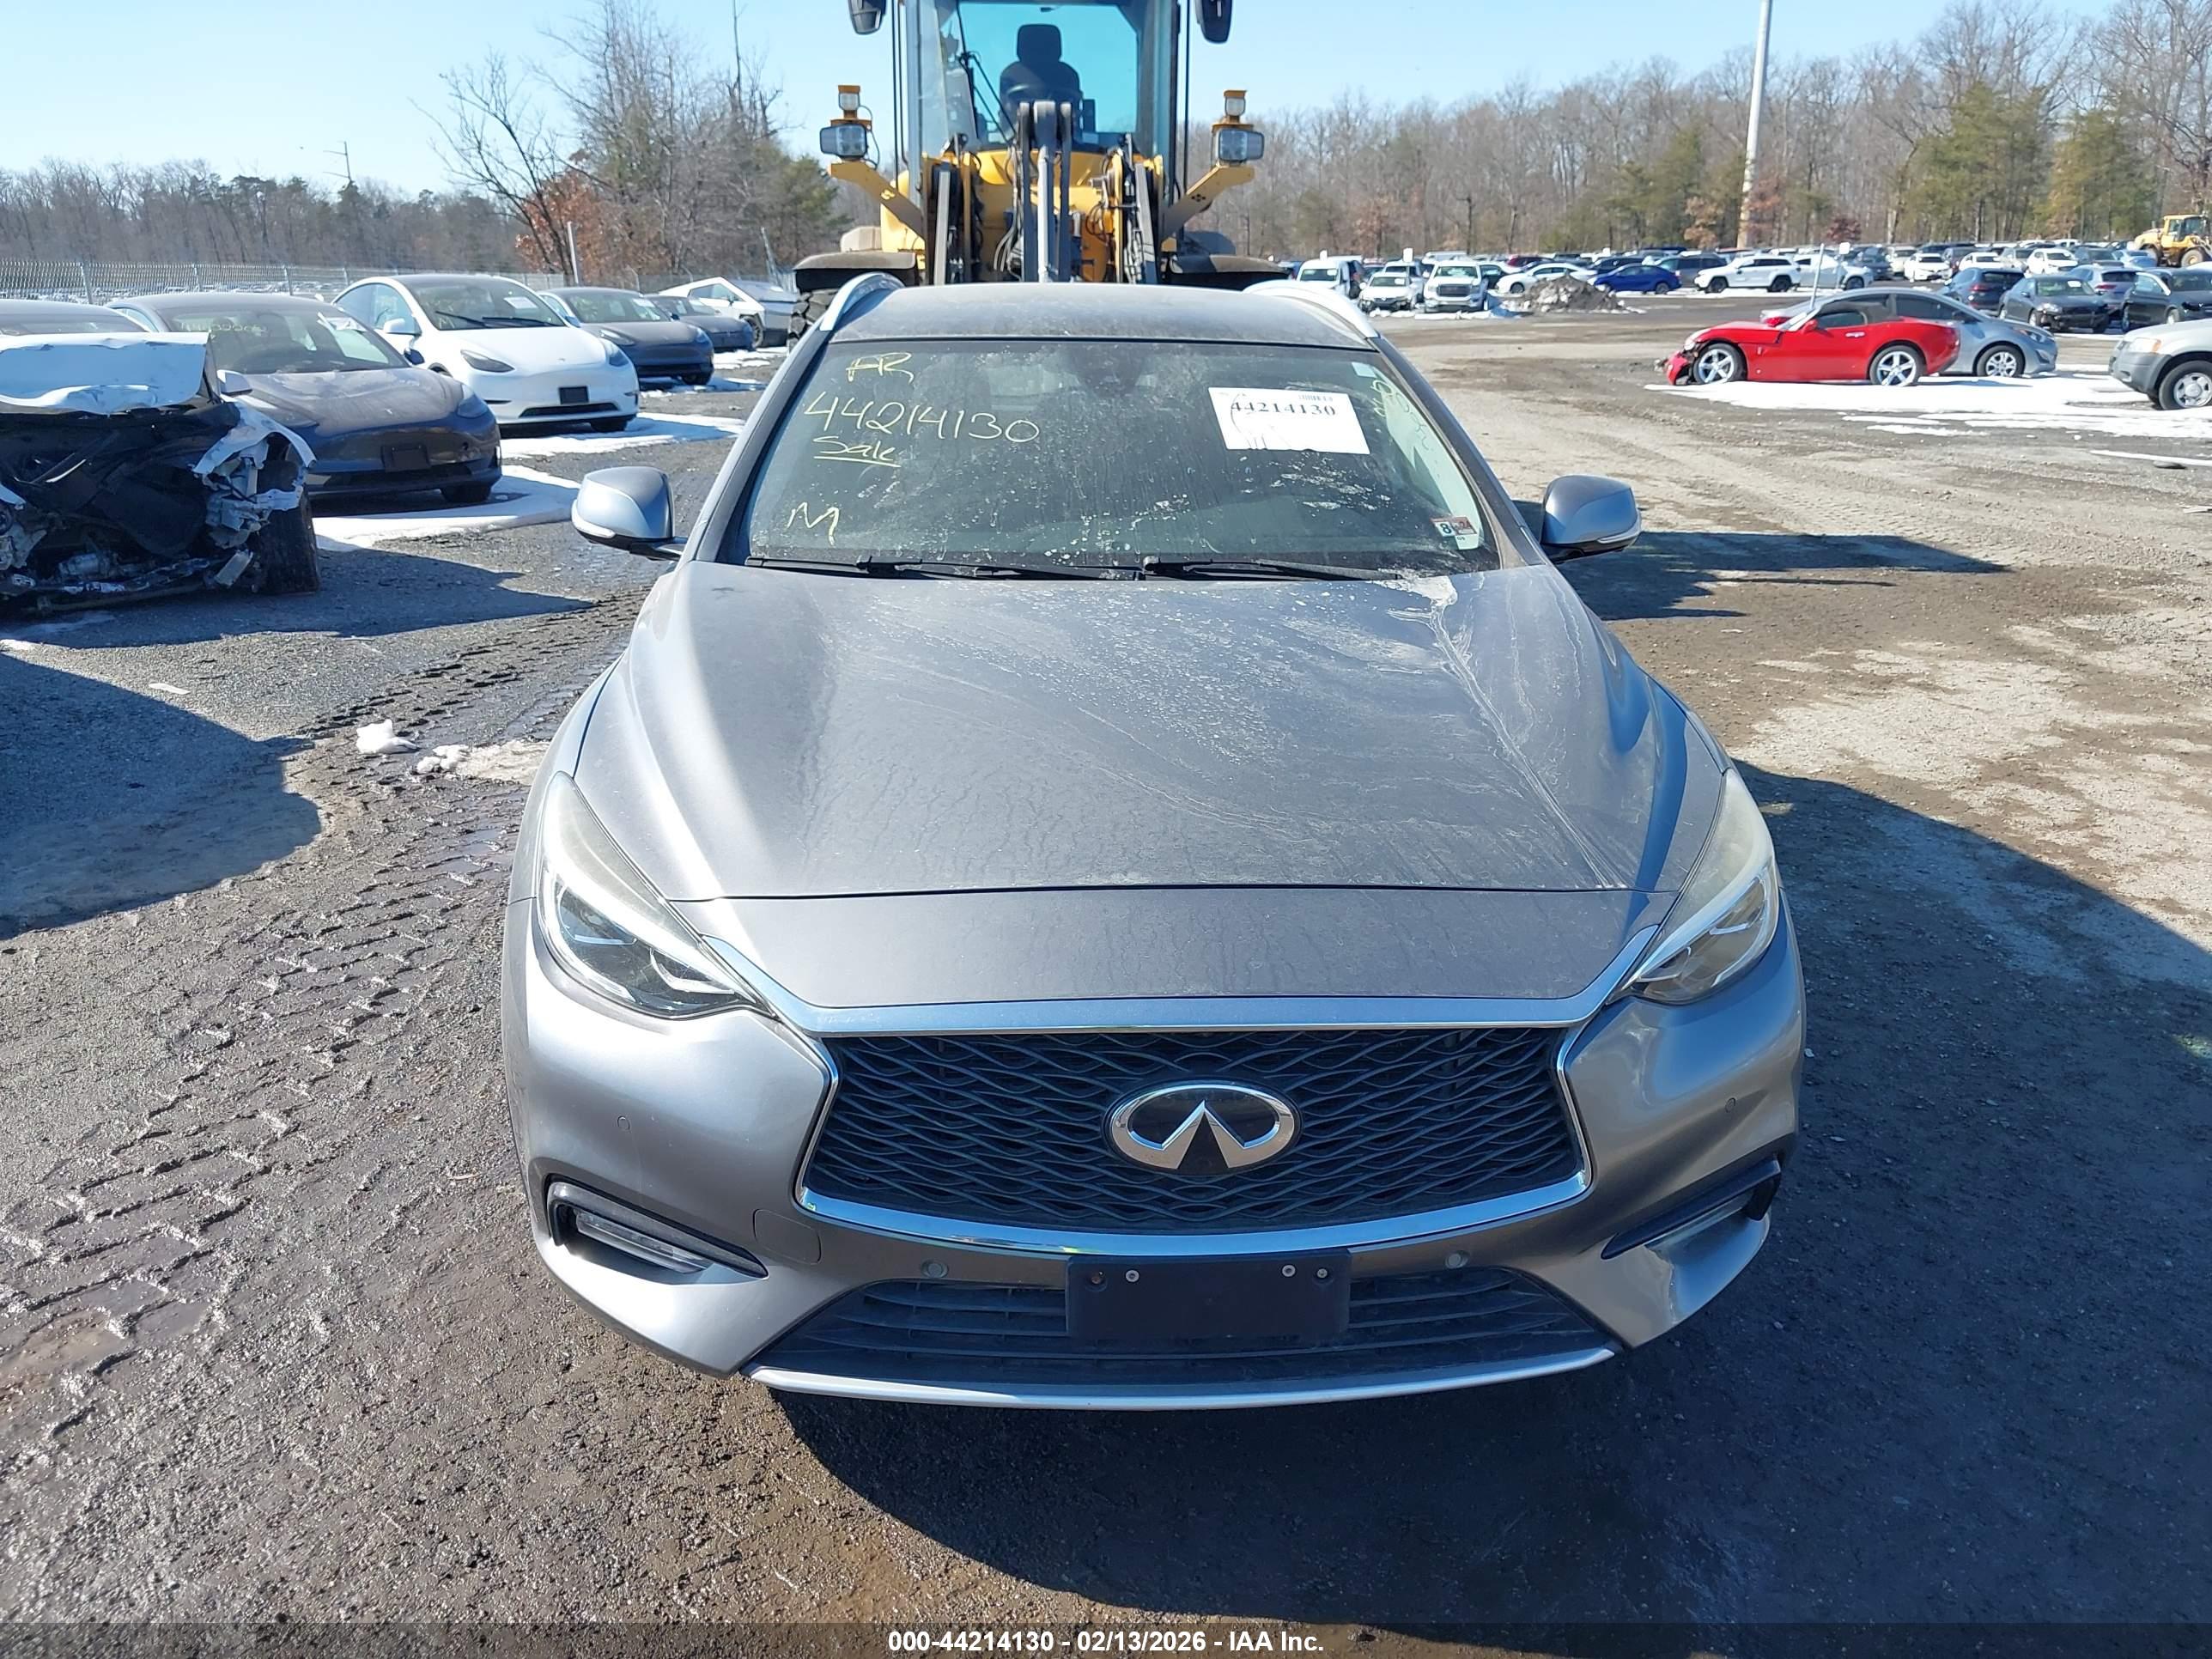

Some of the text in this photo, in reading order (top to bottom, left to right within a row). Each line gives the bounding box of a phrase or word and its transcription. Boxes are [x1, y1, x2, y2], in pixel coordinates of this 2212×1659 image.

[803, 391, 1041, 443] 44214130
[1231, 401, 1336, 416] 44214130
[812, 435, 896, 462] Sale
[787, 501, 841, 546] M
[1439, 522, 1453, 534] 8
